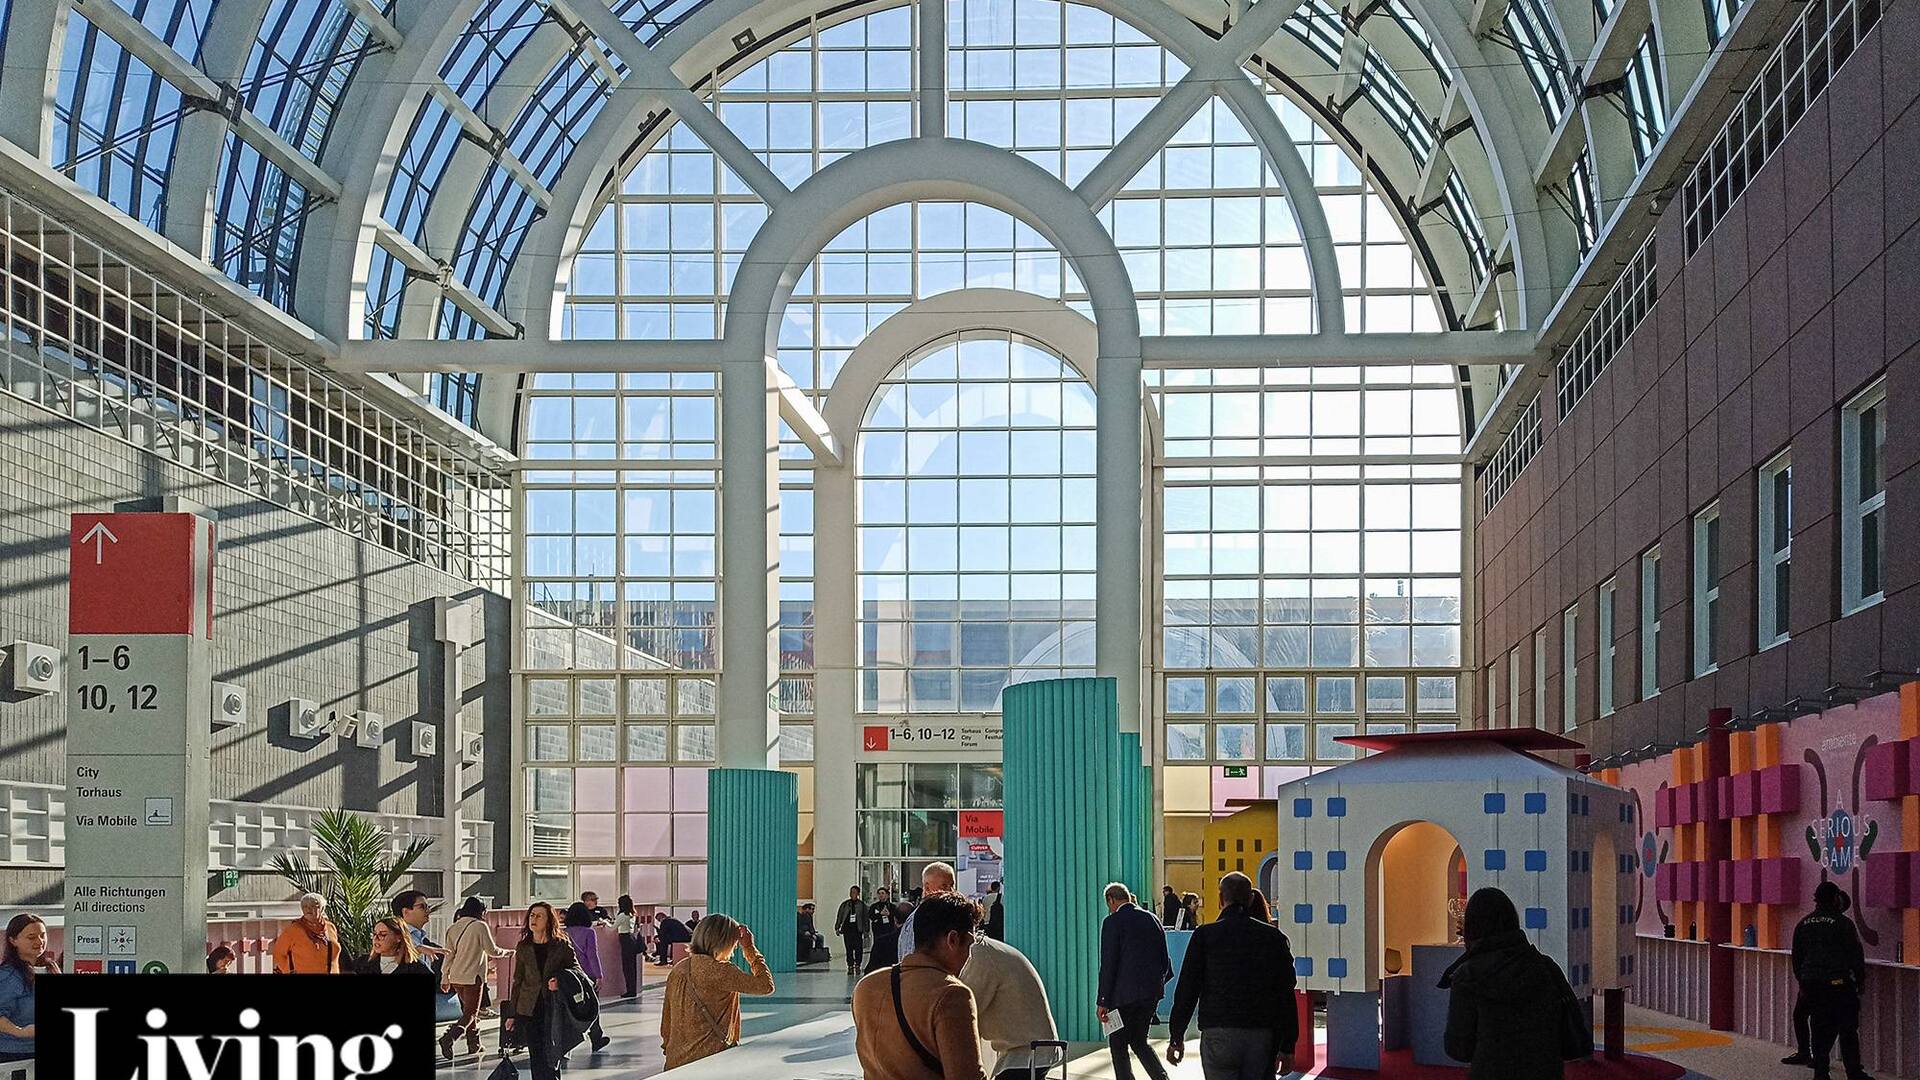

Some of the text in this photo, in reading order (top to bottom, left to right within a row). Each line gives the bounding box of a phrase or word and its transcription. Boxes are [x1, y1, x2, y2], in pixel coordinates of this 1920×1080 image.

[78, 645, 130, 671] 1–6
[77, 684, 158, 713] 10, 12
[76, 766, 100, 779] City
[76, 787, 122, 798] Torhaus
[1835, 788, 1845, 810] A
[76, 815, 138, 826] Via Mobile
[965, 815, 978, 823] Via
[965, 825, 994, 834] Mobile
[1811, 814, 1871, 840] SERIOUS
[1820, 845, 1860, 868] GAME
[74, 886, 166, 899] Alle Richtungen
[74, 902, 145, 913] All directions
[77, 936, 100, 944] Press
